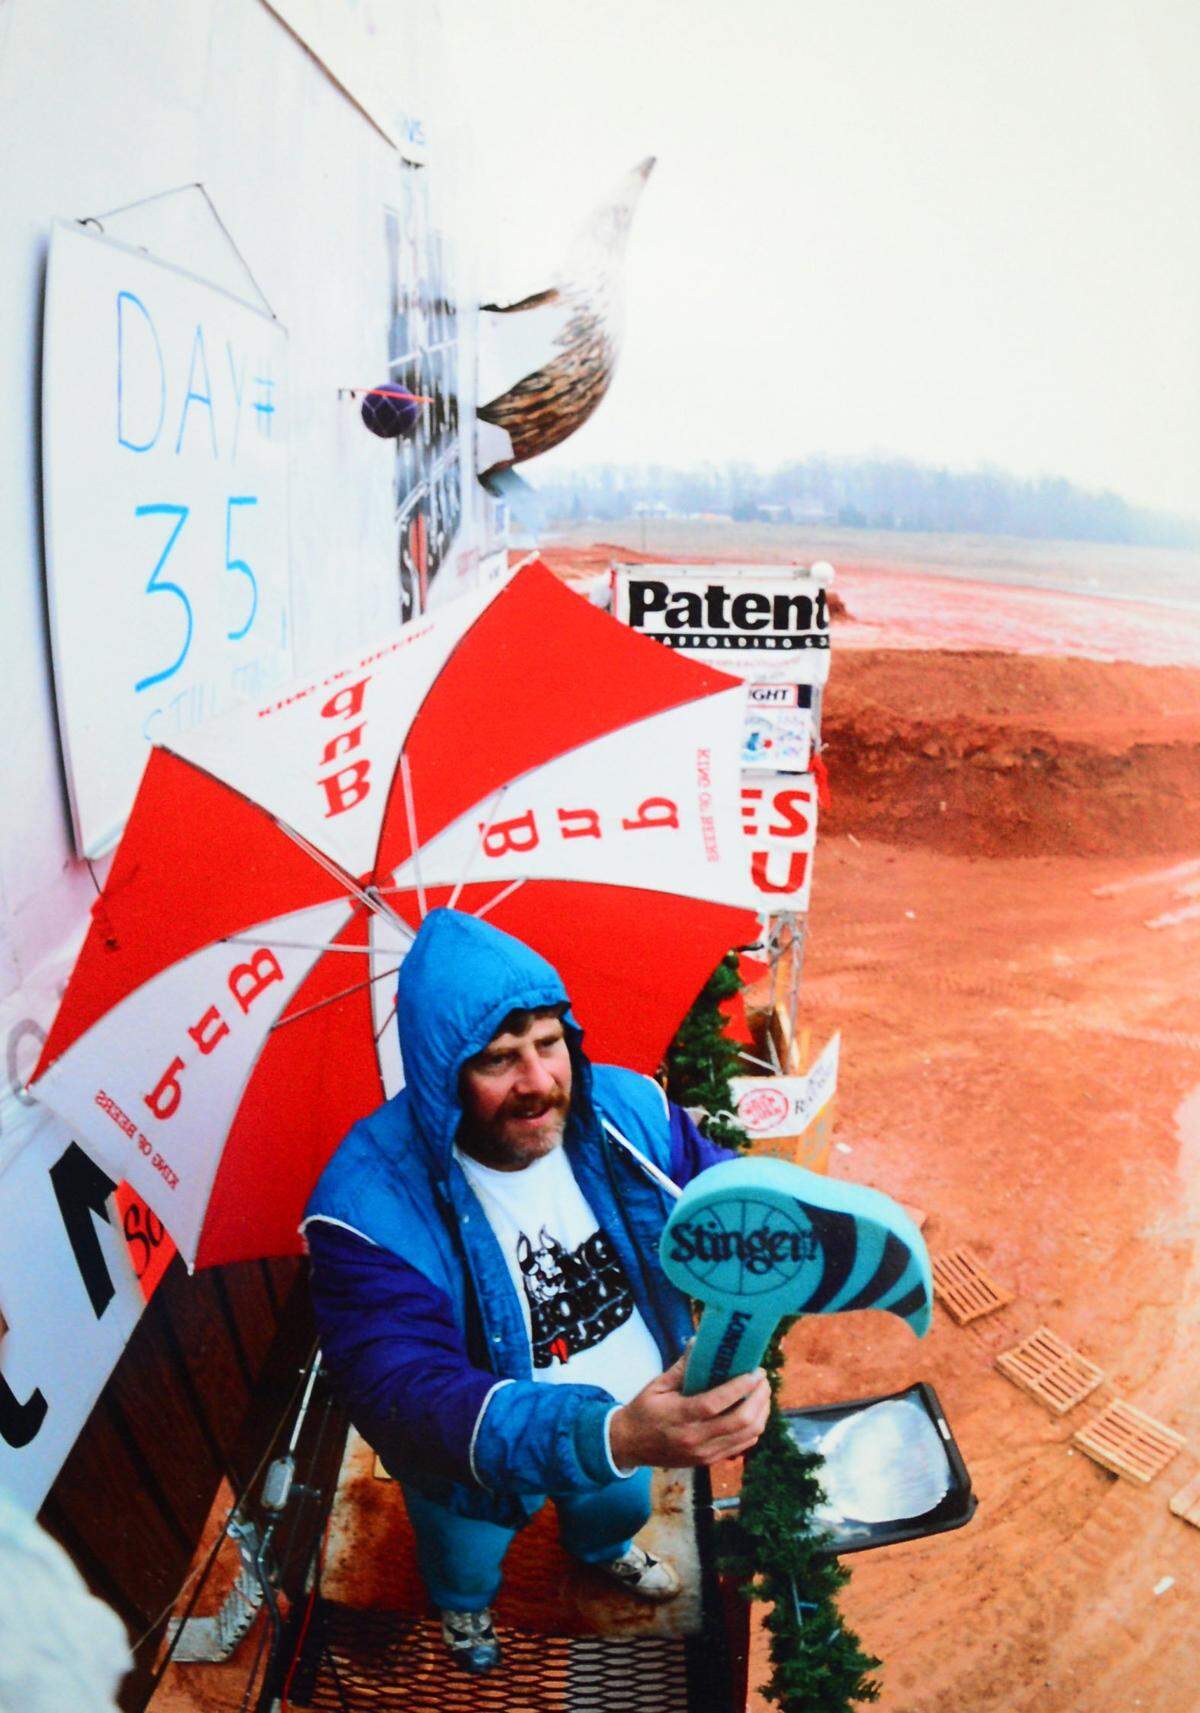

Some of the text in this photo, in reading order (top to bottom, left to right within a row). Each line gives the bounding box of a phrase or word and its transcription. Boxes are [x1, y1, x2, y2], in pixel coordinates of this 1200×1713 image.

[135, 496, 258, 694] 35
[628, 580, 830, 631] Patent
[651, 635, 792, 649] AFFOLDING
